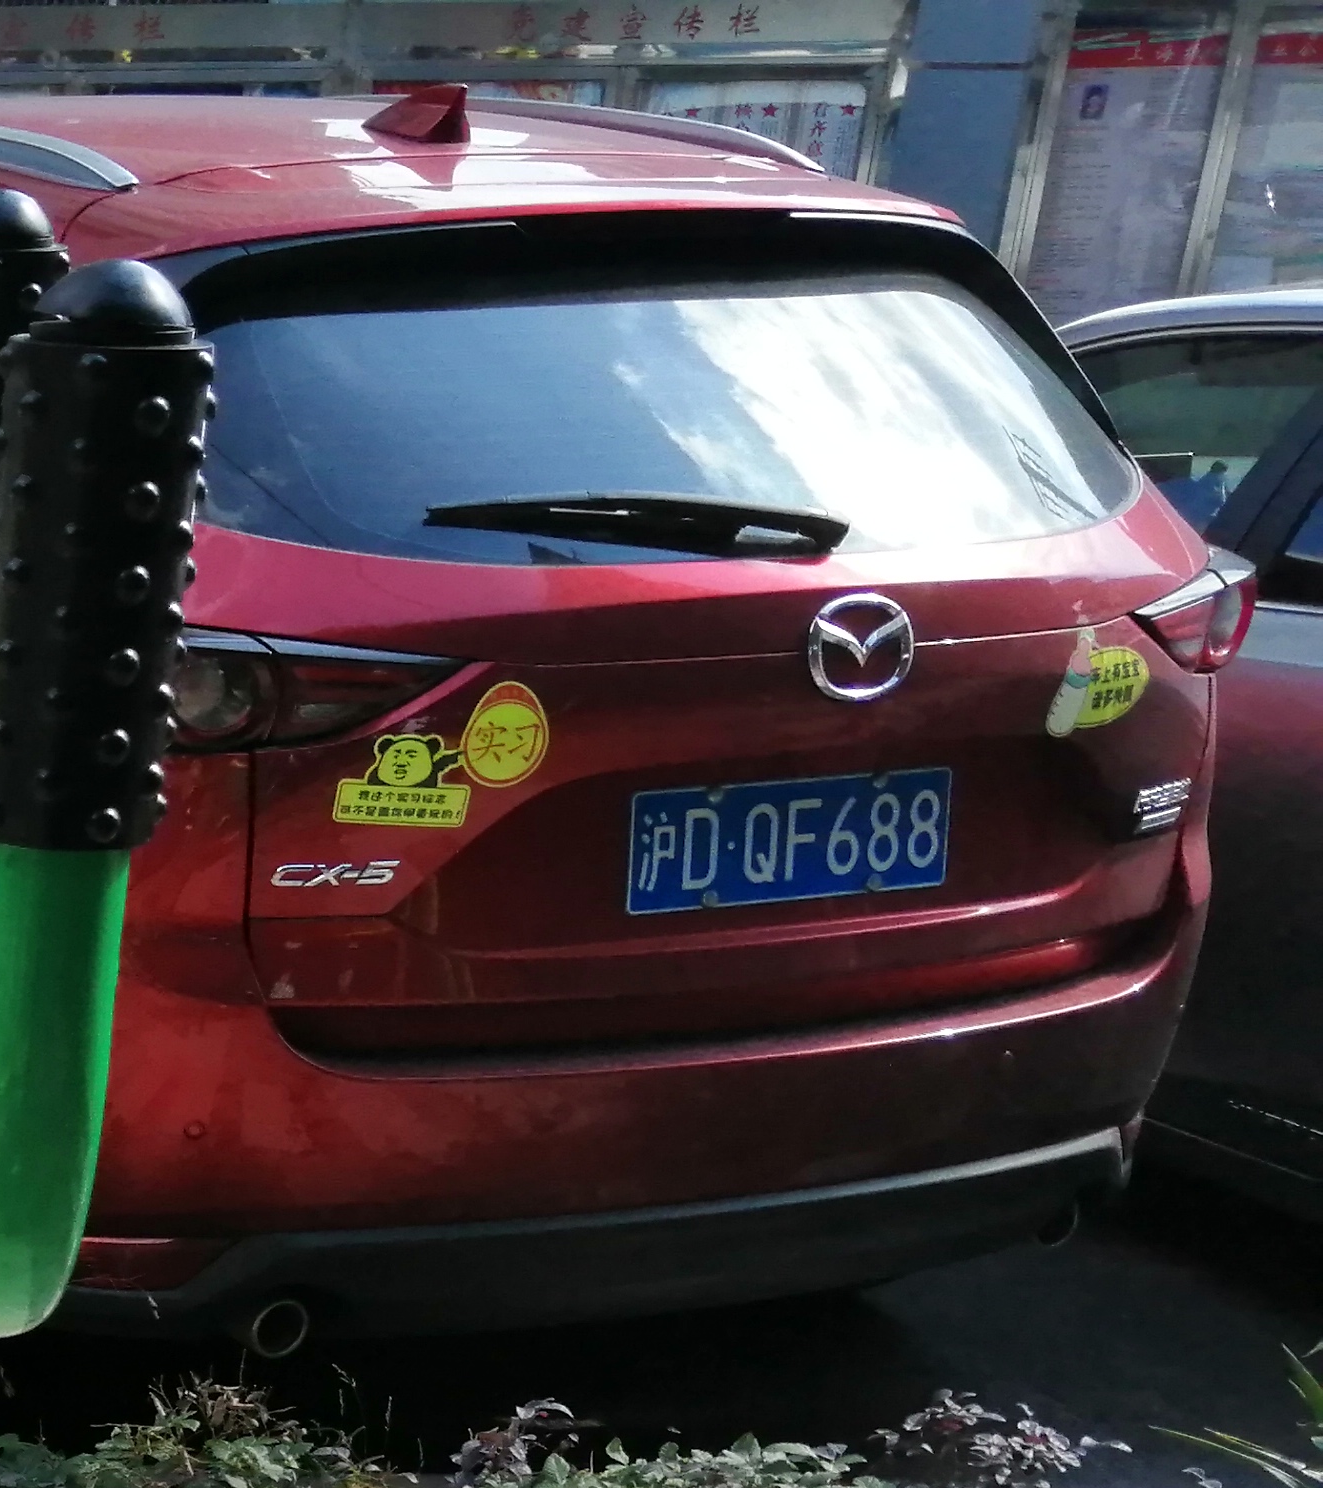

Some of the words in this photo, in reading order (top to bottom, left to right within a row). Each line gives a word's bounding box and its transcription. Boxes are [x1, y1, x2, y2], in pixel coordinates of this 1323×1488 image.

[471, 721, 542, 763] 实习
[637, 789, 941, 892] 沪D·QF688
[270, 860, 401, 887] CX-5
